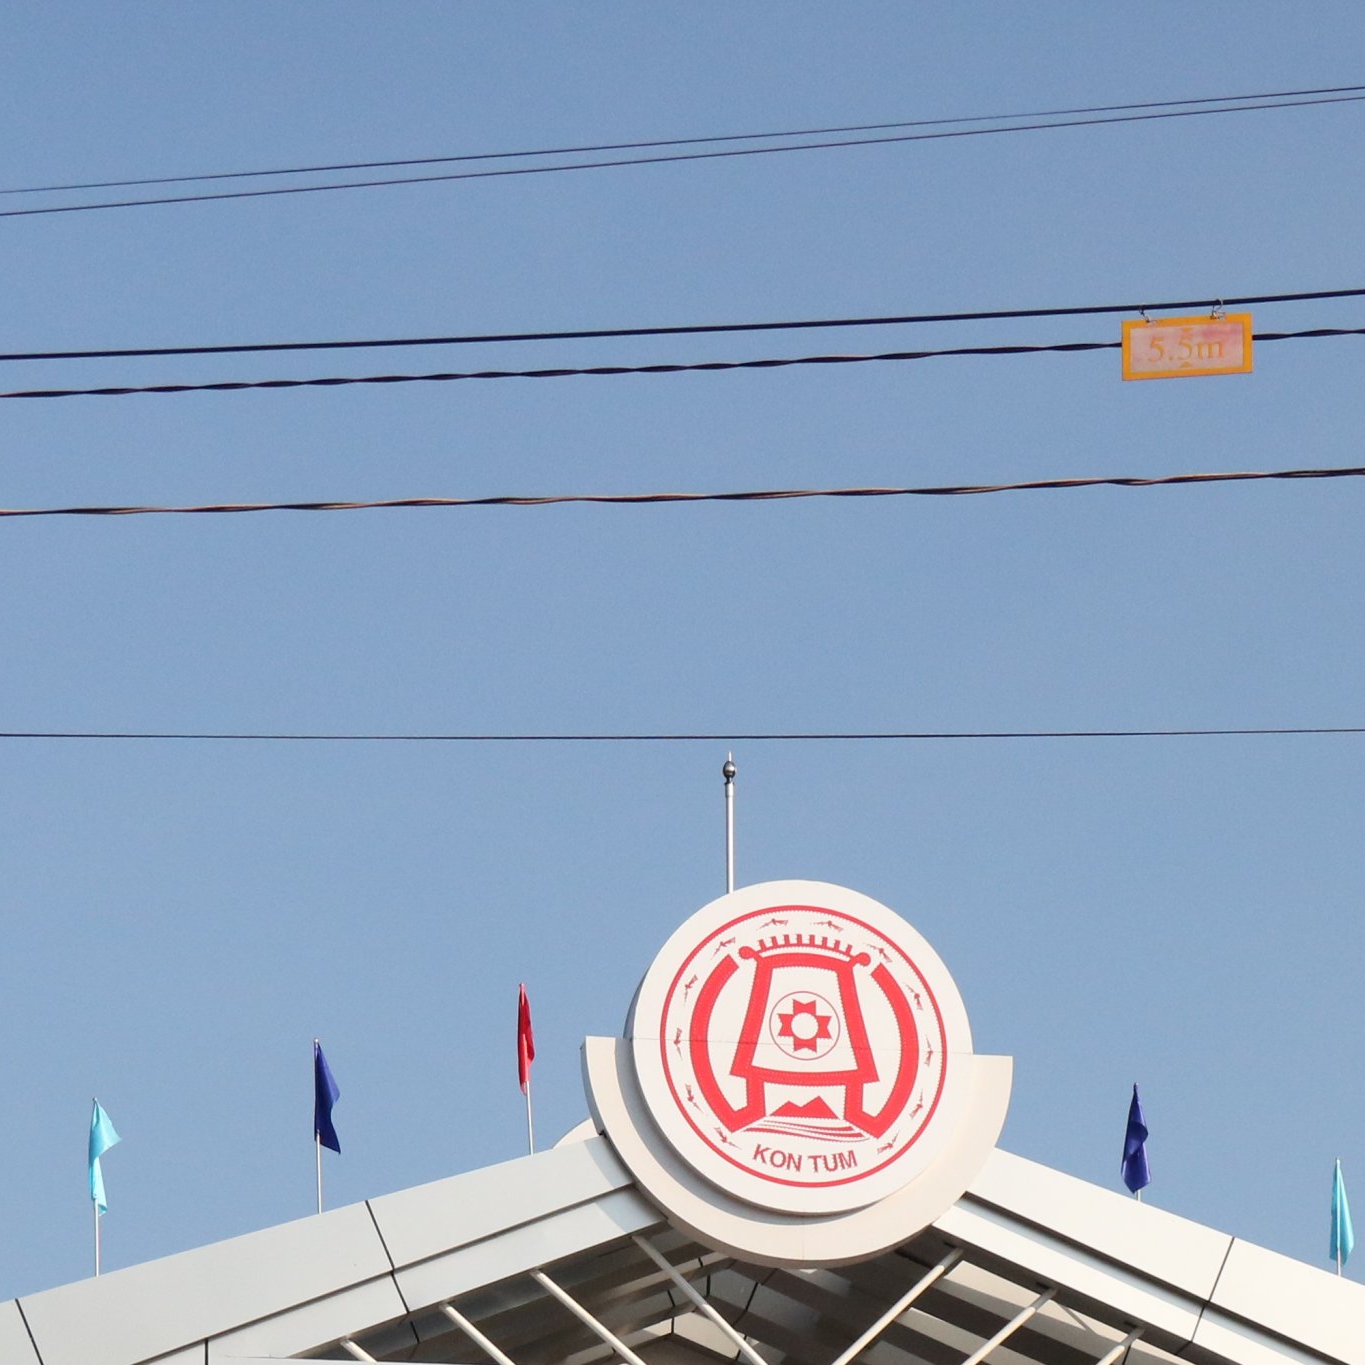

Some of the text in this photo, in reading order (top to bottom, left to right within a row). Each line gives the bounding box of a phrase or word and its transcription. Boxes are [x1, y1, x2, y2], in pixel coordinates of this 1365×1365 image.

[1147, 335, 1225, 363] 5.5m
[752, 1143, 858, 1173] KON TUM
